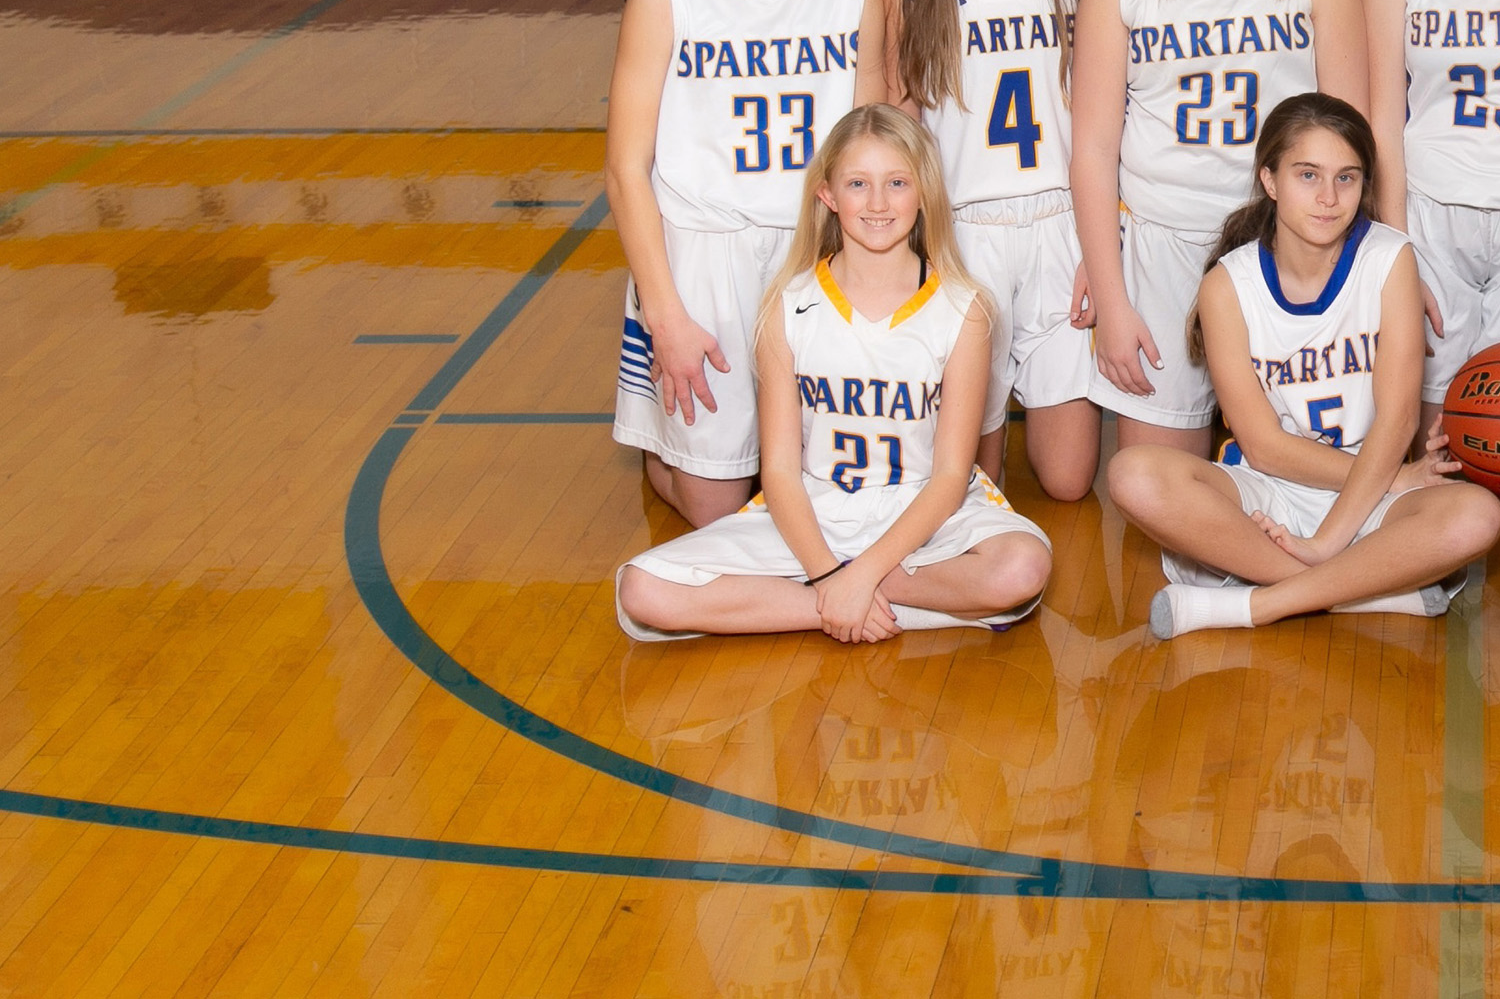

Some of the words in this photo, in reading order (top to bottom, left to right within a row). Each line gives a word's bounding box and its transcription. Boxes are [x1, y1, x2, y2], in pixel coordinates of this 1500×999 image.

[677, 29, 860, 79] SPARTANS
[1130, 11, 1311, 65] SPARTANS
[731, 91, 816, 175] 33
[985, 67, 1044, 171] 4
[1174, 70, 1261, 148] 23
[797, 372, 942, 421] PARTAN
[1305, 393, 1344, 449] 5
[830, 429, 905, 494] 21
